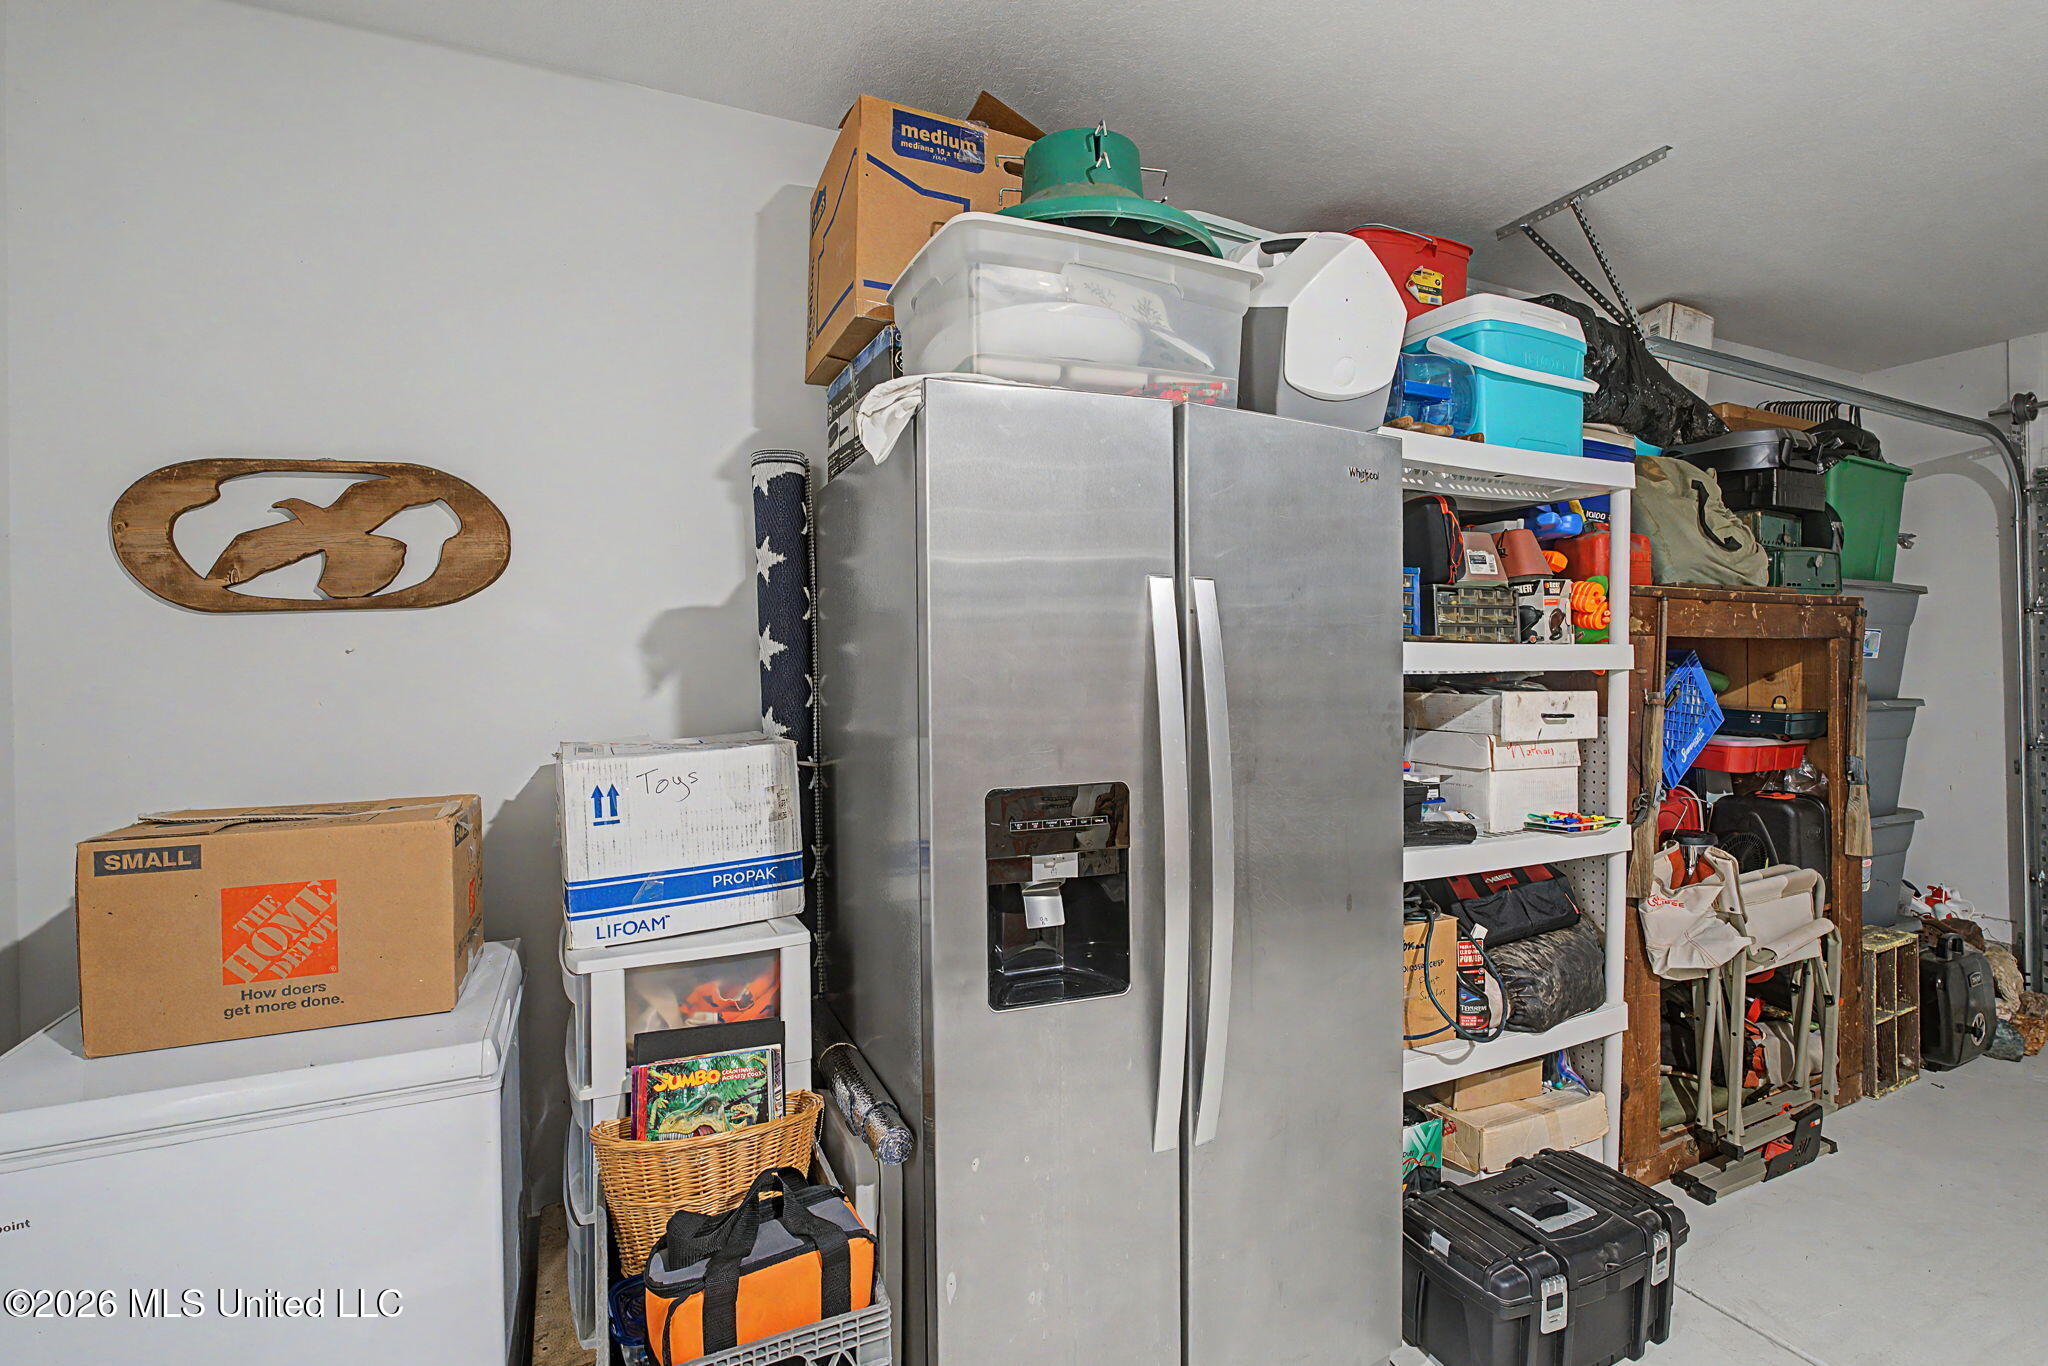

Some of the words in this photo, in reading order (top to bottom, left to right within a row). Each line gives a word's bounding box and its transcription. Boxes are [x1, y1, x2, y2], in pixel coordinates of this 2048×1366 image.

[901, 124, 977, 155] medium
[636, 768, 699, 802] Toys
[104, 849, 192, 872] SMALL
[712, 866, 777, 888] PROPAK
[233, 894, 282, 934] THE
[223, 881, 338, 982] HOME
[596, 916, 667, 940] LIFOAM
[268, 915, 338, 979] DEPOT
[241, 988, 277, 1001] How
[281, 983, 327, 997] doers
[223, 1004, 251, 1020] get
[255, 1000, 297, 1014] more
[301, 995, 345, 1008] done.
[653, 1068, 721, 1093] JUMBO
